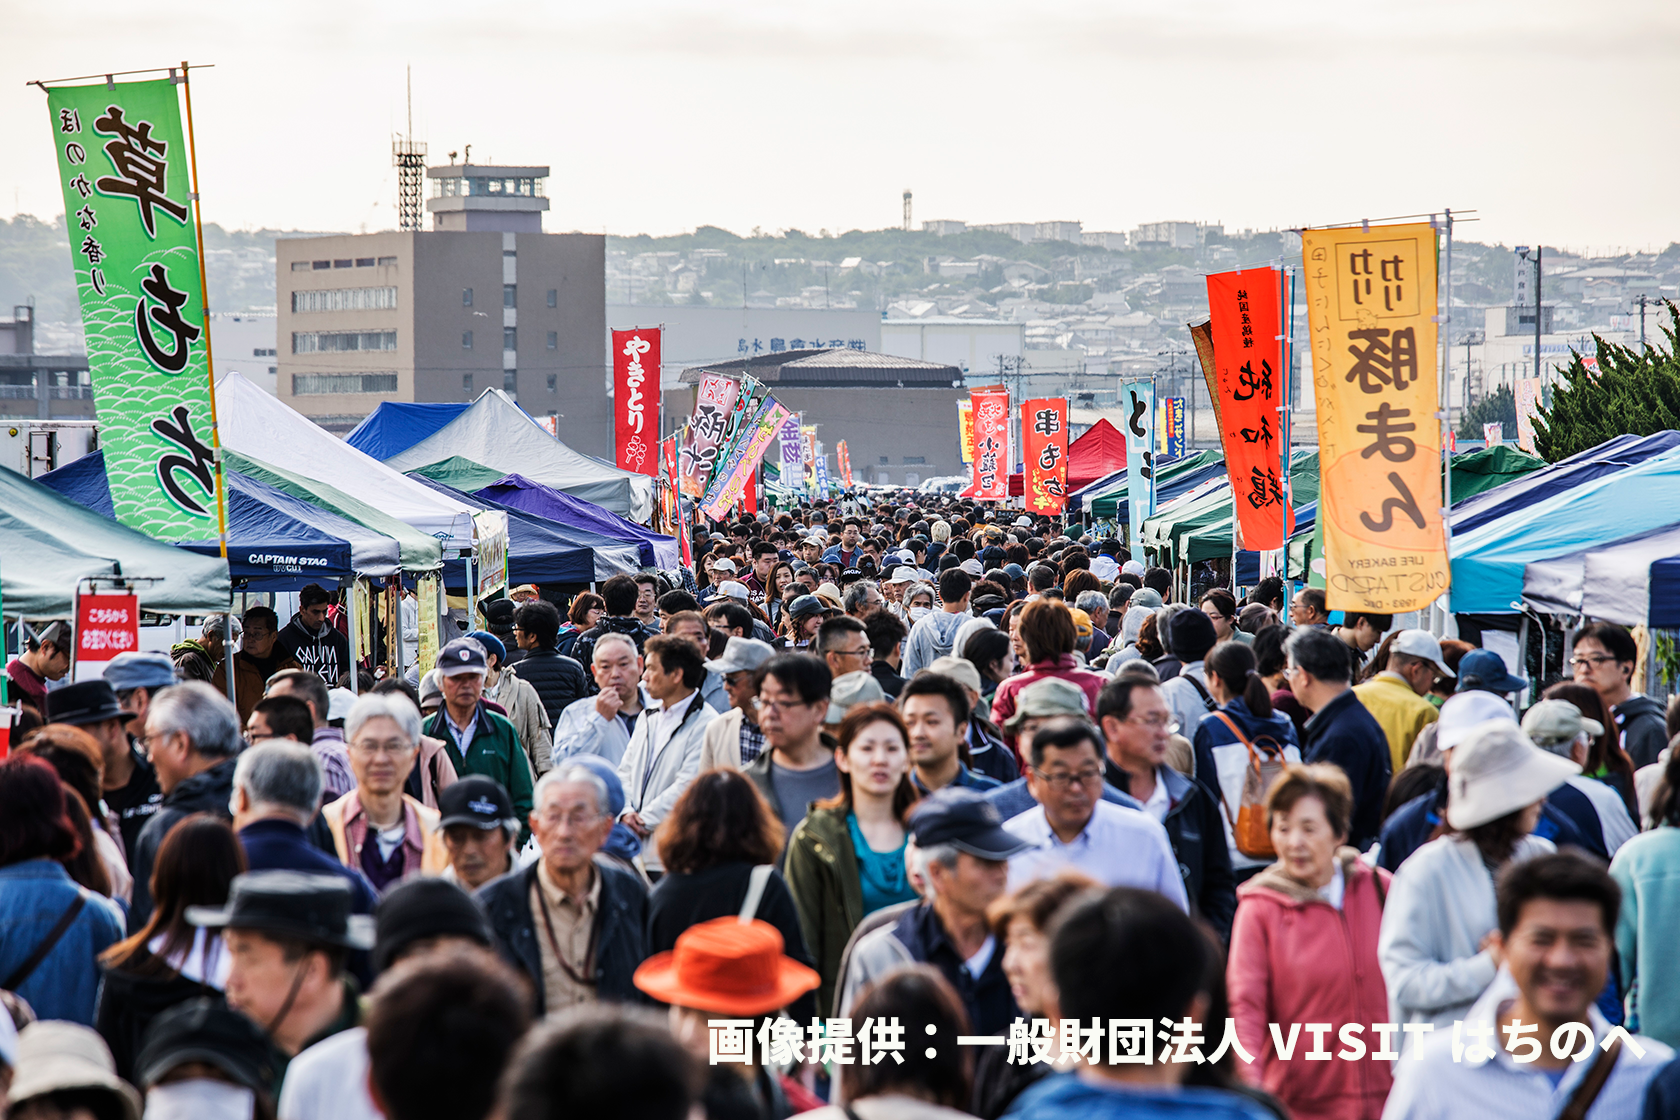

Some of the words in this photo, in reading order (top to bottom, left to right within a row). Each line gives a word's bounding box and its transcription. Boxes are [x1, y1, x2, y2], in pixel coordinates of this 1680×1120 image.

[622, 335, 651, 434] やきとり
[248, 553, 298, 565] CAPTAIN
[298, 556, 328, 566] STAG
[88, 608, 128, 623] こちらから
